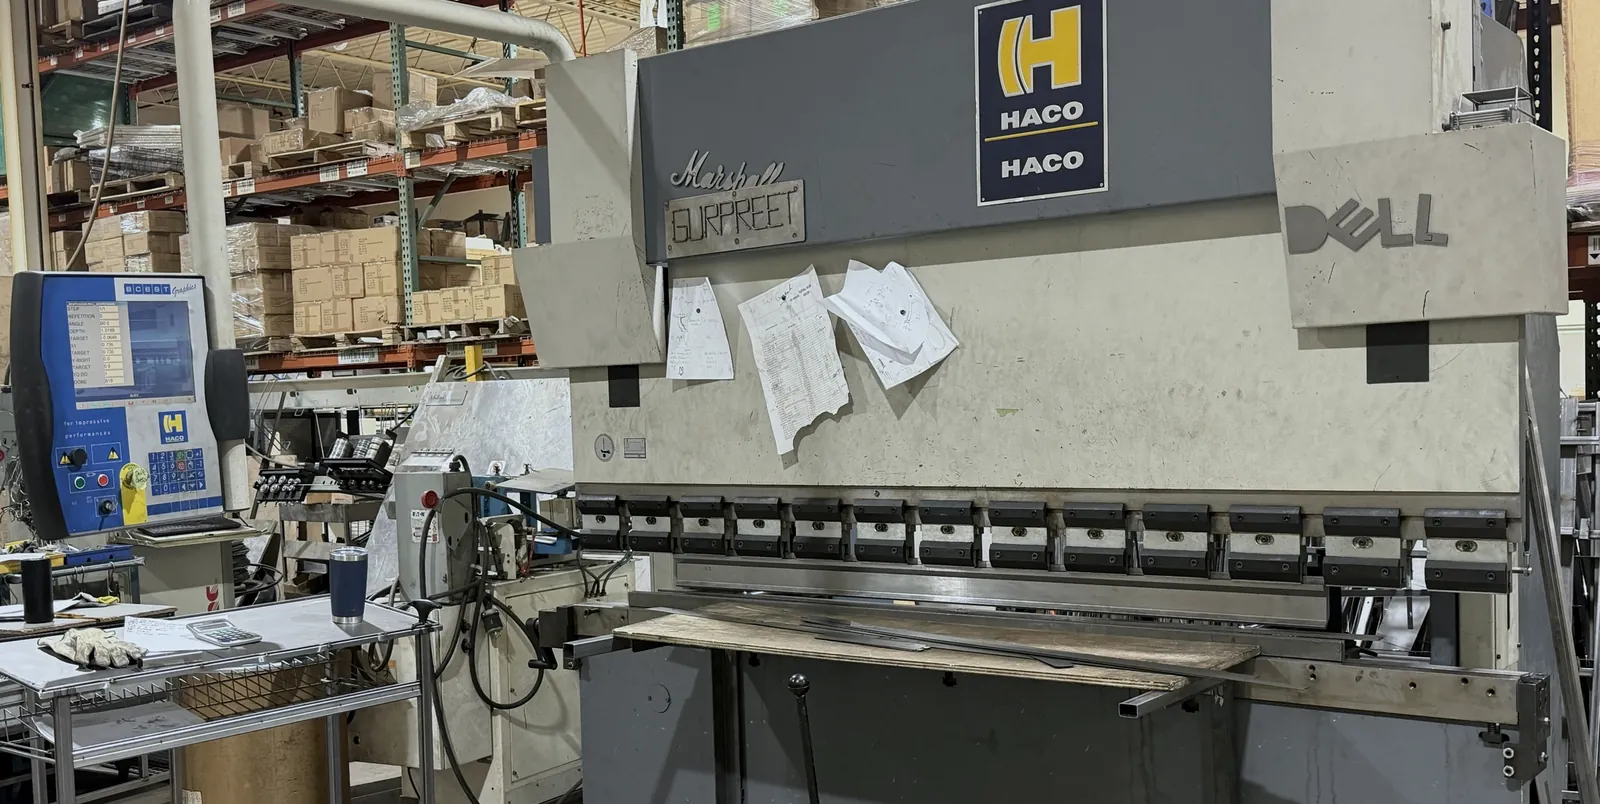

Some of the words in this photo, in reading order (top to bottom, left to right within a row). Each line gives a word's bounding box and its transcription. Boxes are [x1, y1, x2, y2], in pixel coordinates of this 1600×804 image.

[1001, 101, 1084, 130] HACO
[670, 149, 785, 191] Marshall
[1001, 151, 1084, 178] HACO
[672, 188, 799, 243] GURPREET
[1284, 193, 1449, 256] DELL
[171, 284, 197, 297] Graphics
[75, 418, 110, 427] impressive
[64, 430, 111, 440] performances
[165, 434, 185, 443] HACO
[153, 474, 158, 482] 7
[162, 473, 167, 481] 8
